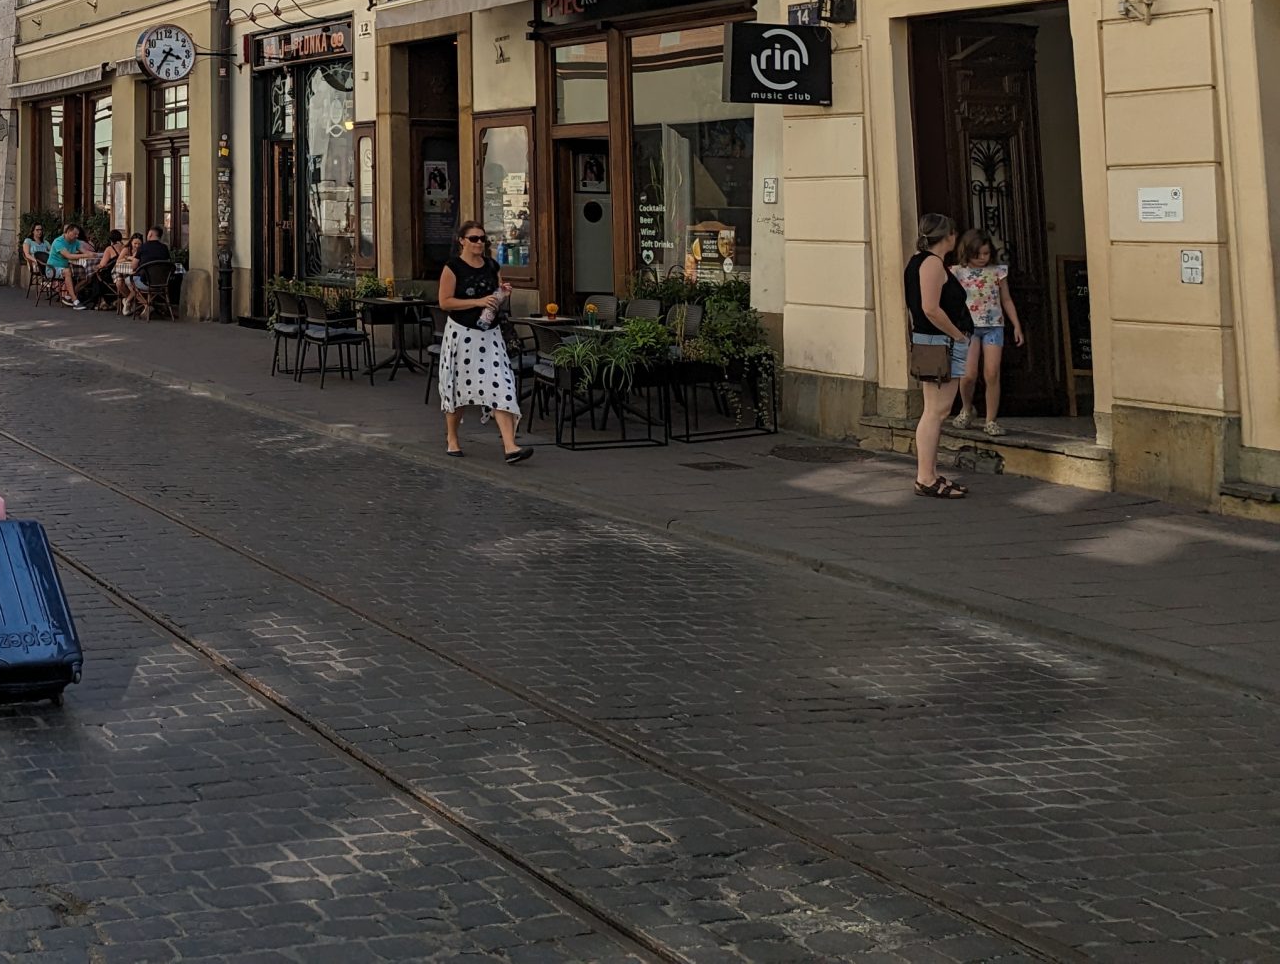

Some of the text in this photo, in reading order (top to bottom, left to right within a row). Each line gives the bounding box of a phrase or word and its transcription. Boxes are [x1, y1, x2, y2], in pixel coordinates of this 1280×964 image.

[797, 9, 810, 26] 14
[361, 23, 369, 33] 12
[155, 31, 163, 40] 11
[164, 29, 172, 38] 12
[148, 39, 156, 48] 10
[181, 38, 186, 47] 2
[145, 49, 150, 58] 9
[185, 49, 190, 59] 3
[760, 43, 801, 71] rin
[149, 59, 154, 68] 8
[181, 59, 186, 68] 4
[165, 68, 170, 77] 6
[174, 67, 179, 76] 5
[751, 91, 811, 101] music club
[639, 204, 666, 212] Cocktails
[640, 216, 653, 224] Beer
[640, 228, 656, 236] Wine
[641, 240, 674, 249] Soft Drinks
